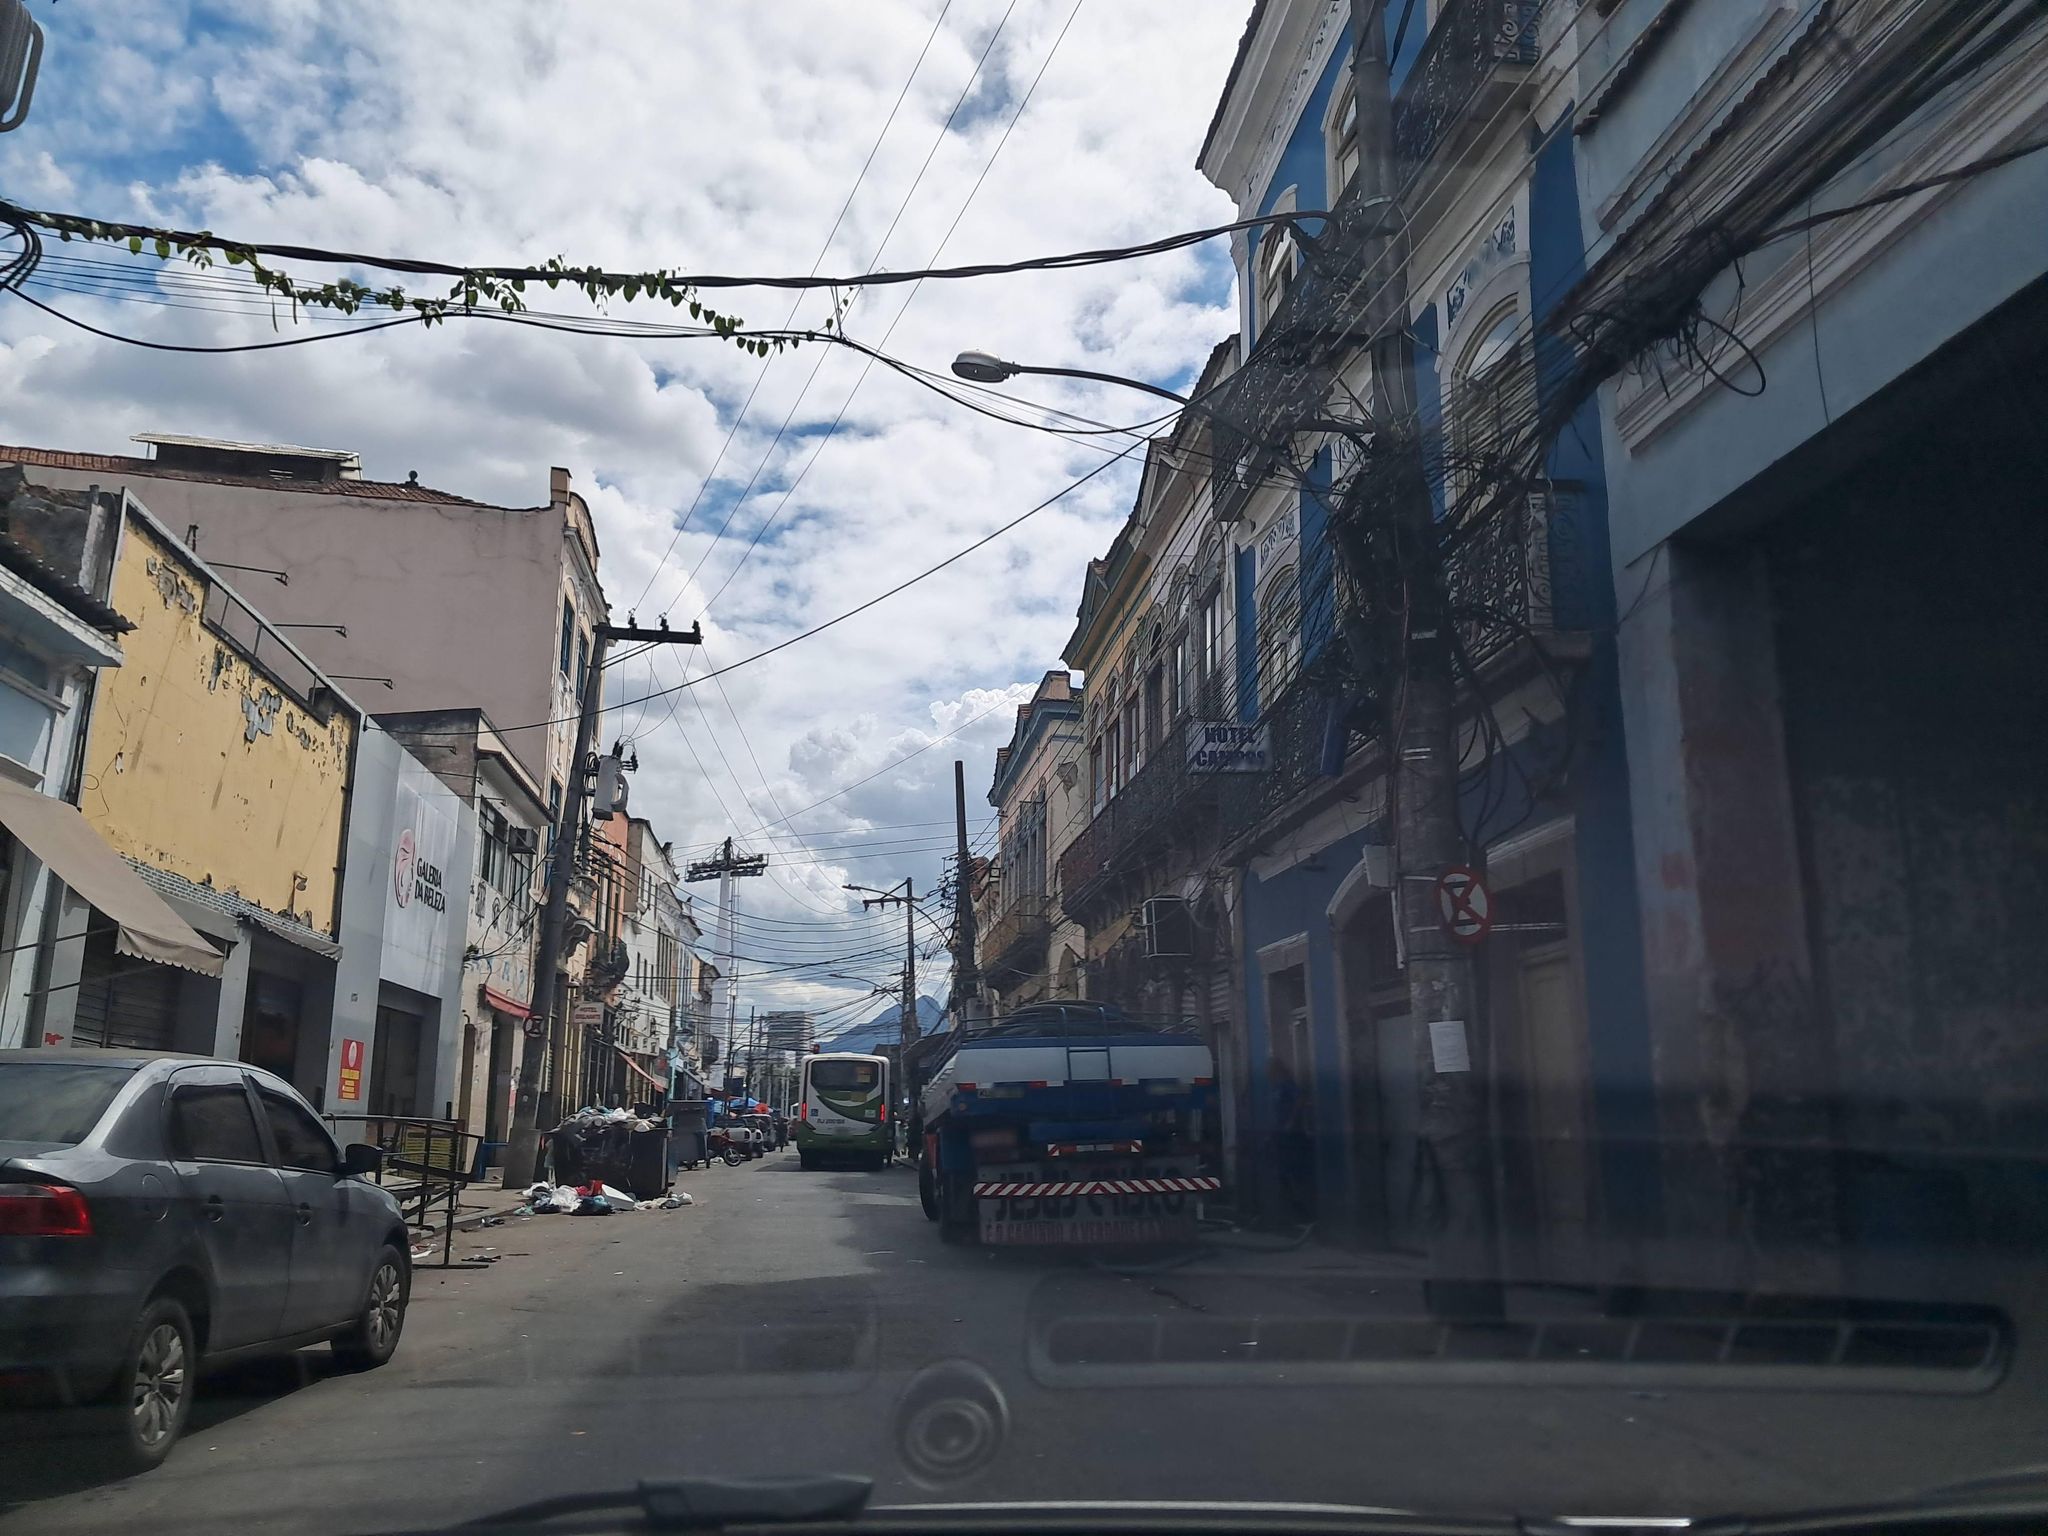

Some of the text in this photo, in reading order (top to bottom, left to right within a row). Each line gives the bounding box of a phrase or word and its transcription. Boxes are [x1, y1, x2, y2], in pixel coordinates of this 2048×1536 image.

[1205, 727, 1256, 743] HOTEL
[416, 857, 442, 890] GALERIA
[414, 879, 445, 914] DA BELEZA
